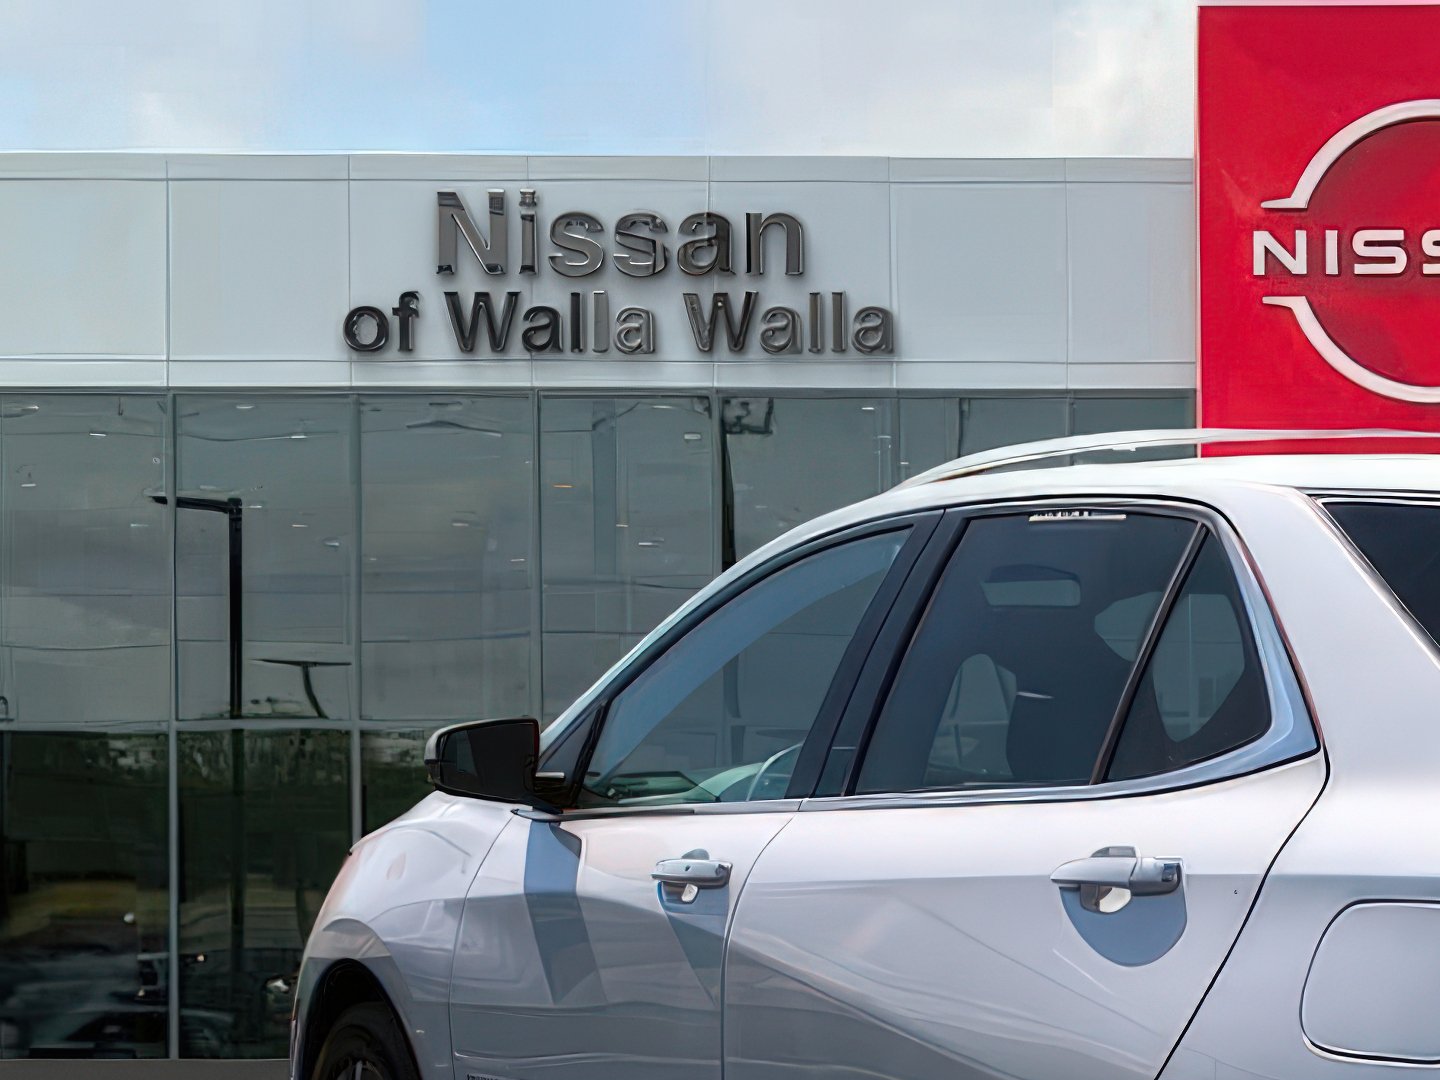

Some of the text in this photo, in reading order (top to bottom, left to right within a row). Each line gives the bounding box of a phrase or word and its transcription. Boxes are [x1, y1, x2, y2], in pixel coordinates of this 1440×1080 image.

[436, 189, 805, 278] Nissan
[342, 290, 896, 355] of Walla Walla
